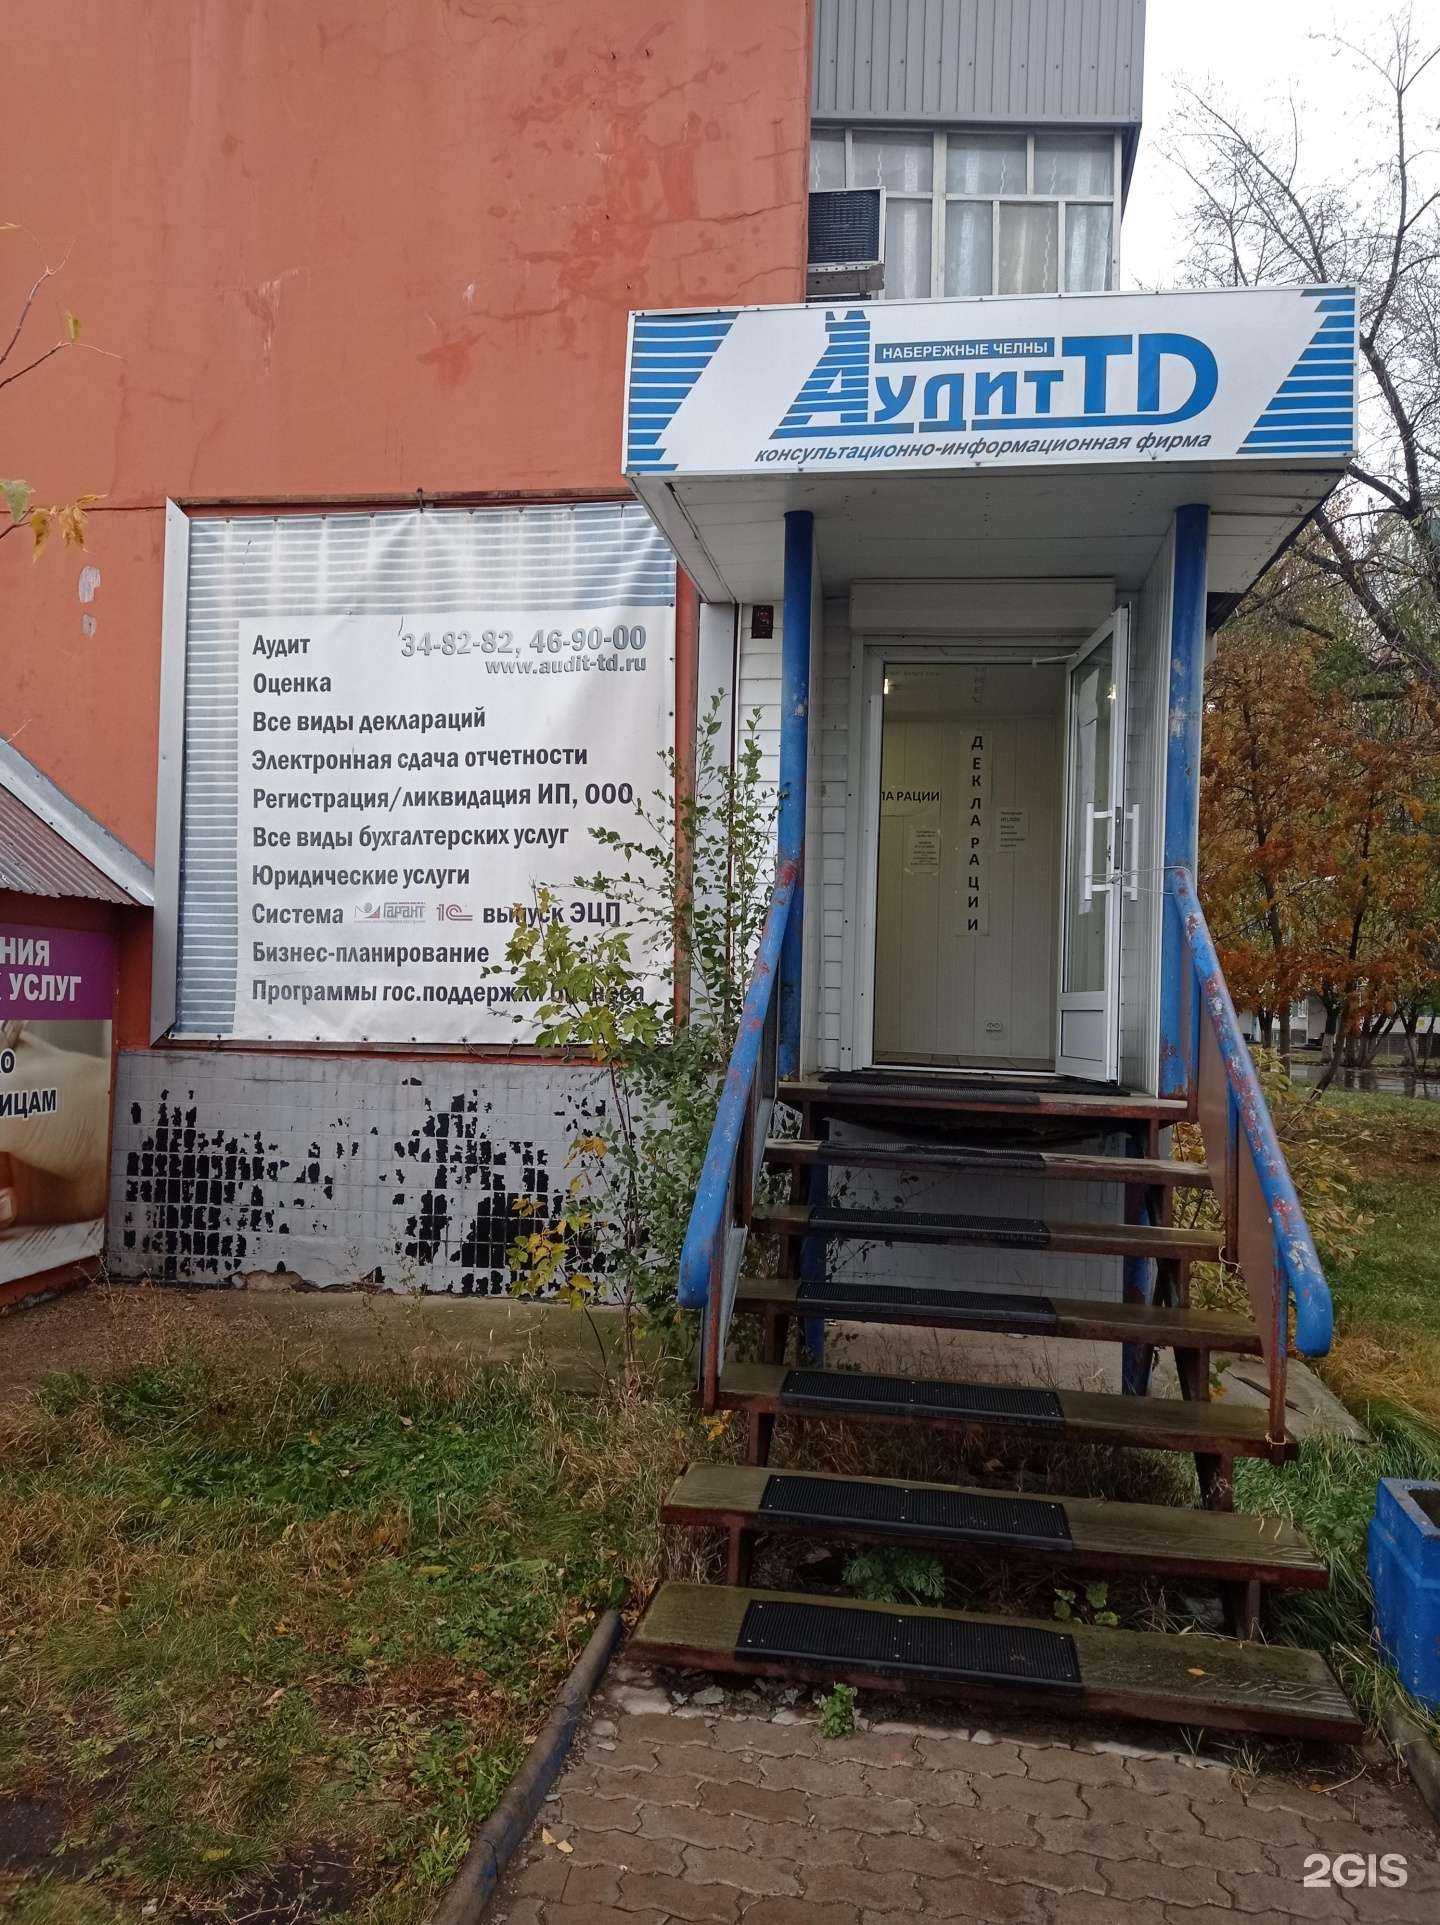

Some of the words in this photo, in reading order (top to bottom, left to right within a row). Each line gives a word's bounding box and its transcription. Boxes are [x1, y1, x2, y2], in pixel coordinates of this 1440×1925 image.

[879, 340, 991, 362] НАБЕРЕЖНЫЕ
[991, 338, 1051, 357] ЧЕЛНЫ
[753, 434, 1134, 465] консультационно-информационная
[1134, 430, 1214, 455] фирма
[252, 634, 311, 660] Аудит
[400, 627, 523, 660] 34-82-82,
[529, 624, 648, 654] 46-90-00
[484, 654, 648, 675] www.audit-td.ru
[253, 672, 332, 697] Оценка
[253, 711, 291, 732] Все
[297, 715, 354, 734] виды
[358, 706, 486, 734] деклараций
[251, 749, 392, 775] Электронная
[397, 751, 459, 772] сдача
[464, 748, 588, 768] отчетности
[253, 786, 531, 813] Регистрация/ликвидация
[538, 783, 578, 809] ИП,
[584, 782, 635, 805] ООО
[253, 826, 291, 847] Все
[296, 831, 353, 850] виды
[359, 825, 510, 852] бухгалтерских
[513, 828, 569, 850] услуг
[967, 734, 984, 932] ДЕКЛАРАЦИИ
[252, 864, 399, 889] Юридические
[402, 868, 470, 890] услуги
[251, 902, 344, 924] Система
[570, 902, 621, 927] ЭЦП
[252, 941, 490, 968] Бизнес-планирование
[9, 973, 82, 1002] УСЛУГ
[252, 979, 377, 1006] Программы
